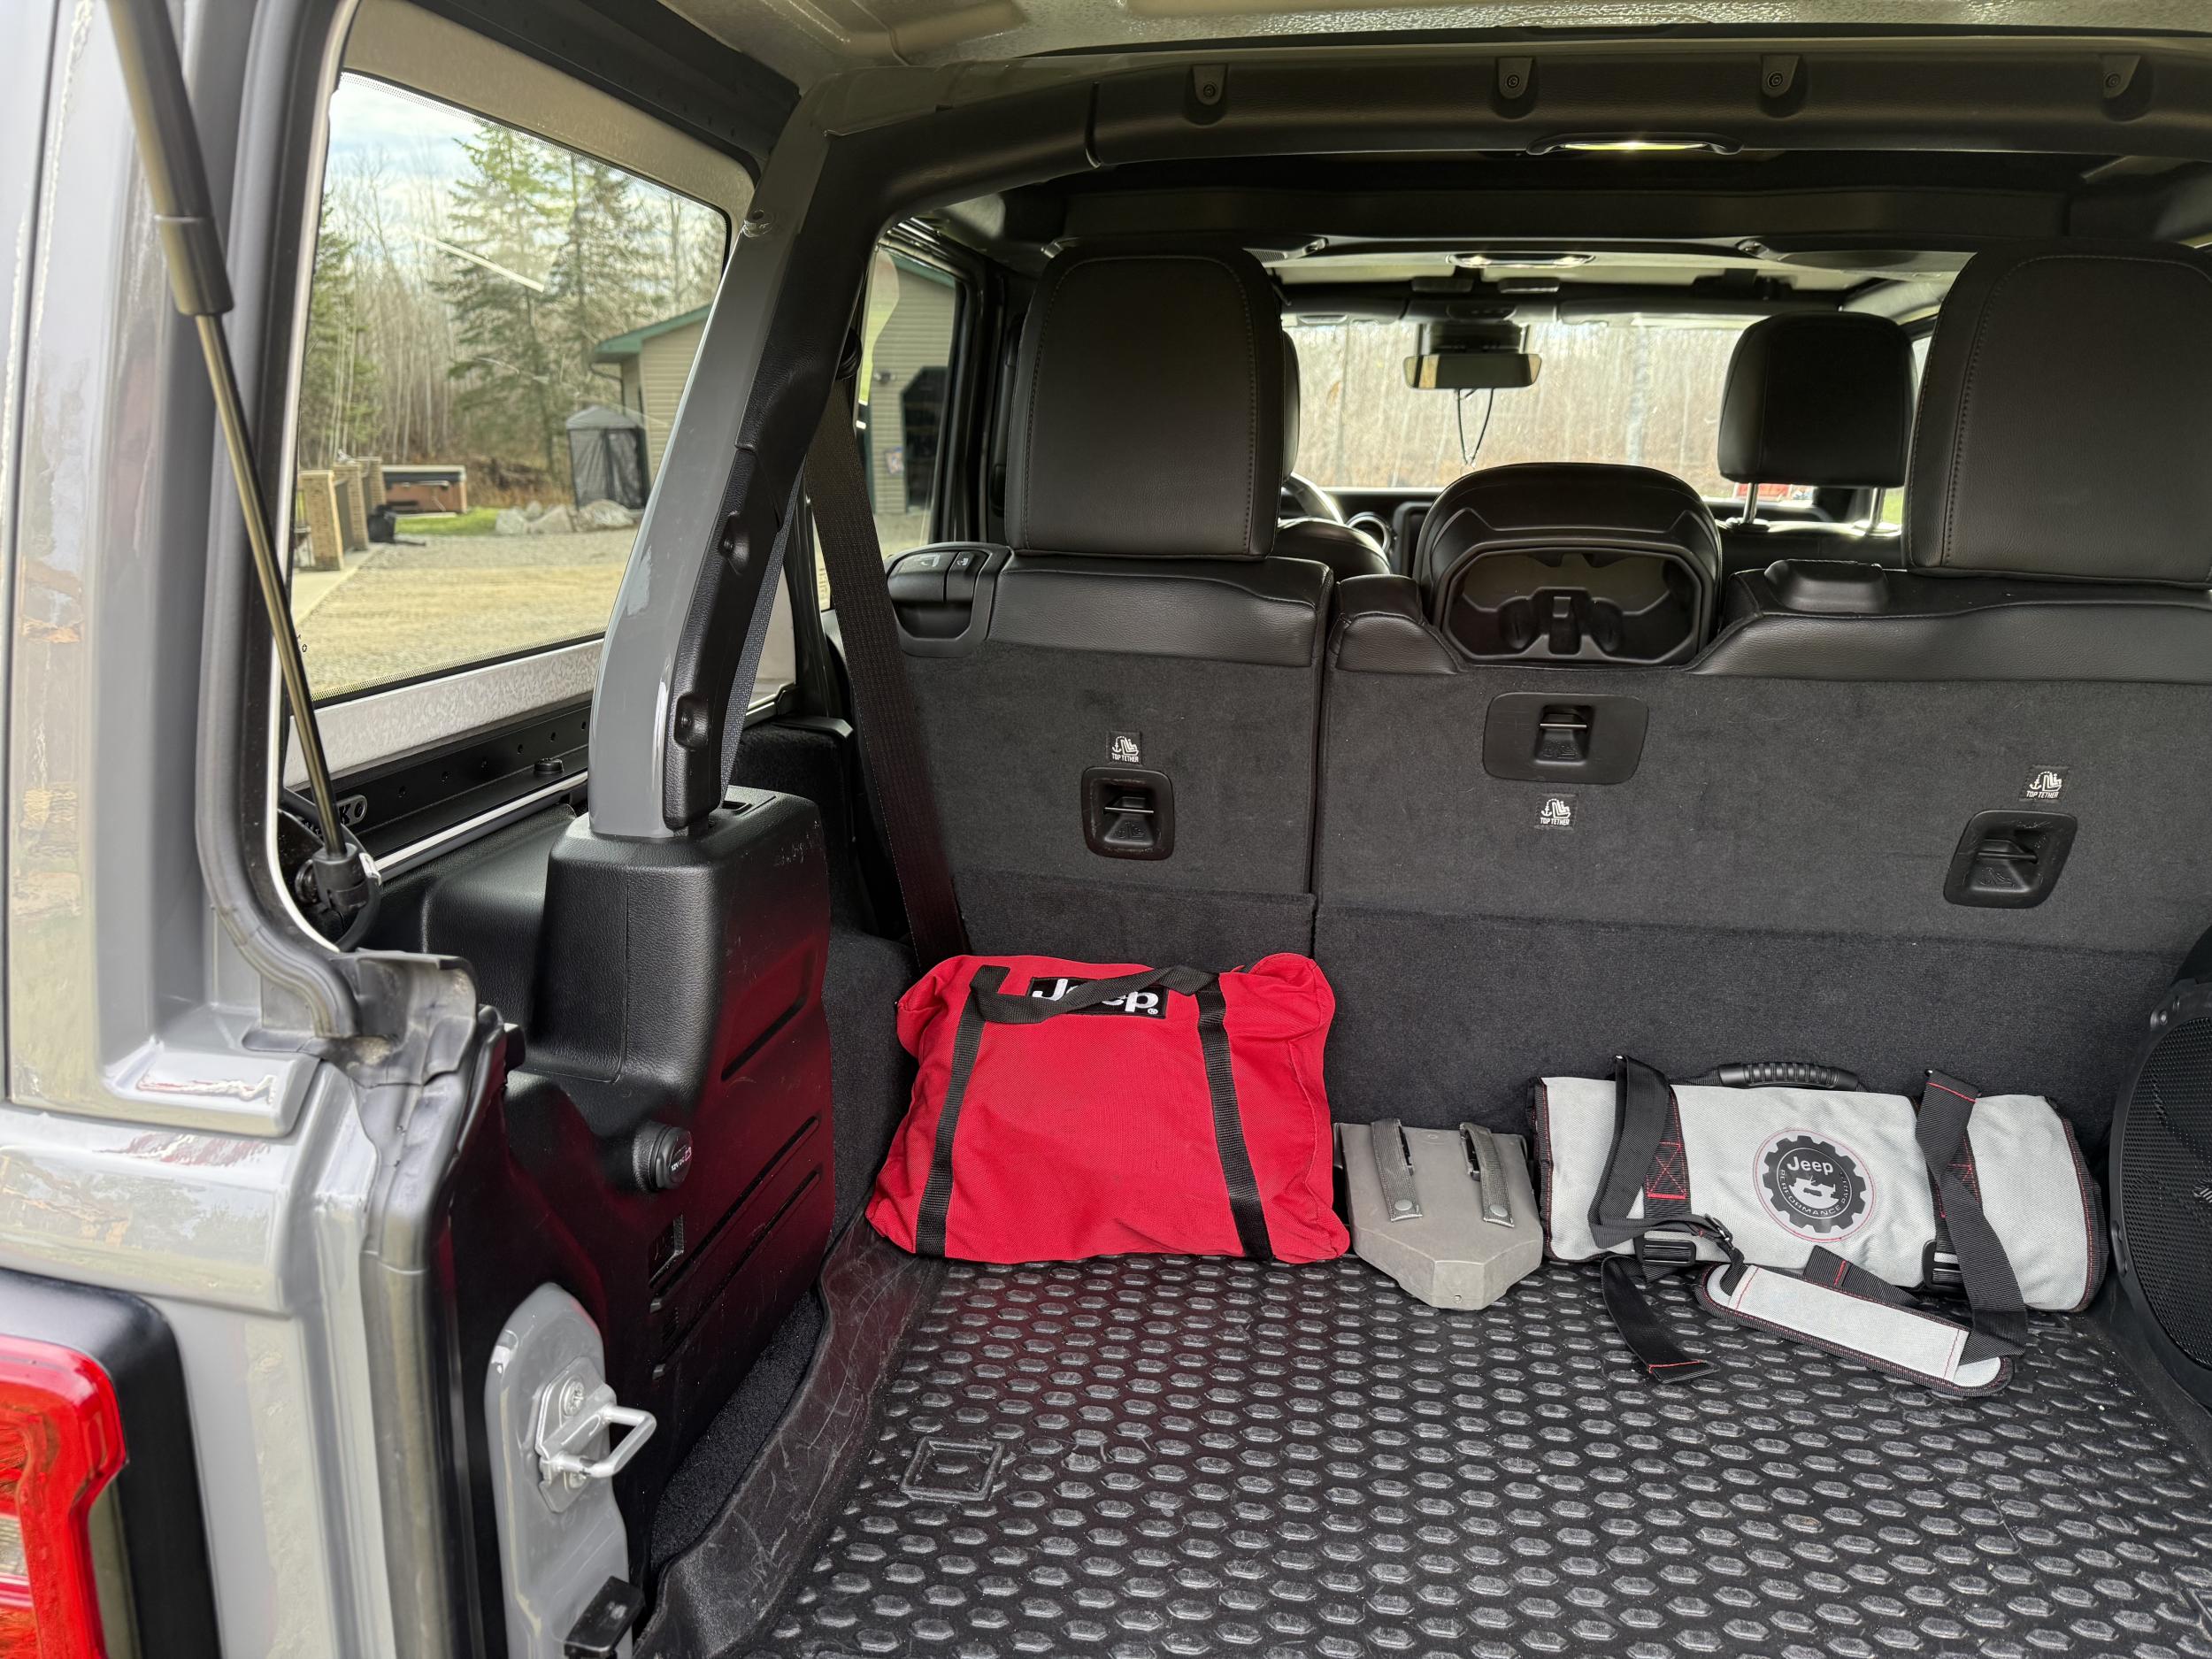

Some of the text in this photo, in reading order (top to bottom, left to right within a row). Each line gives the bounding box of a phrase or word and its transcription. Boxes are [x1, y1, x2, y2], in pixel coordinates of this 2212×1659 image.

[1111, 752, 1121, 761] TOP
[1032, 978, 1159, 1013] Jp
[1786, 1156, 1834, 1176] Jeep
[1779, 1169, 1841, 1217] PERFORMANCE
